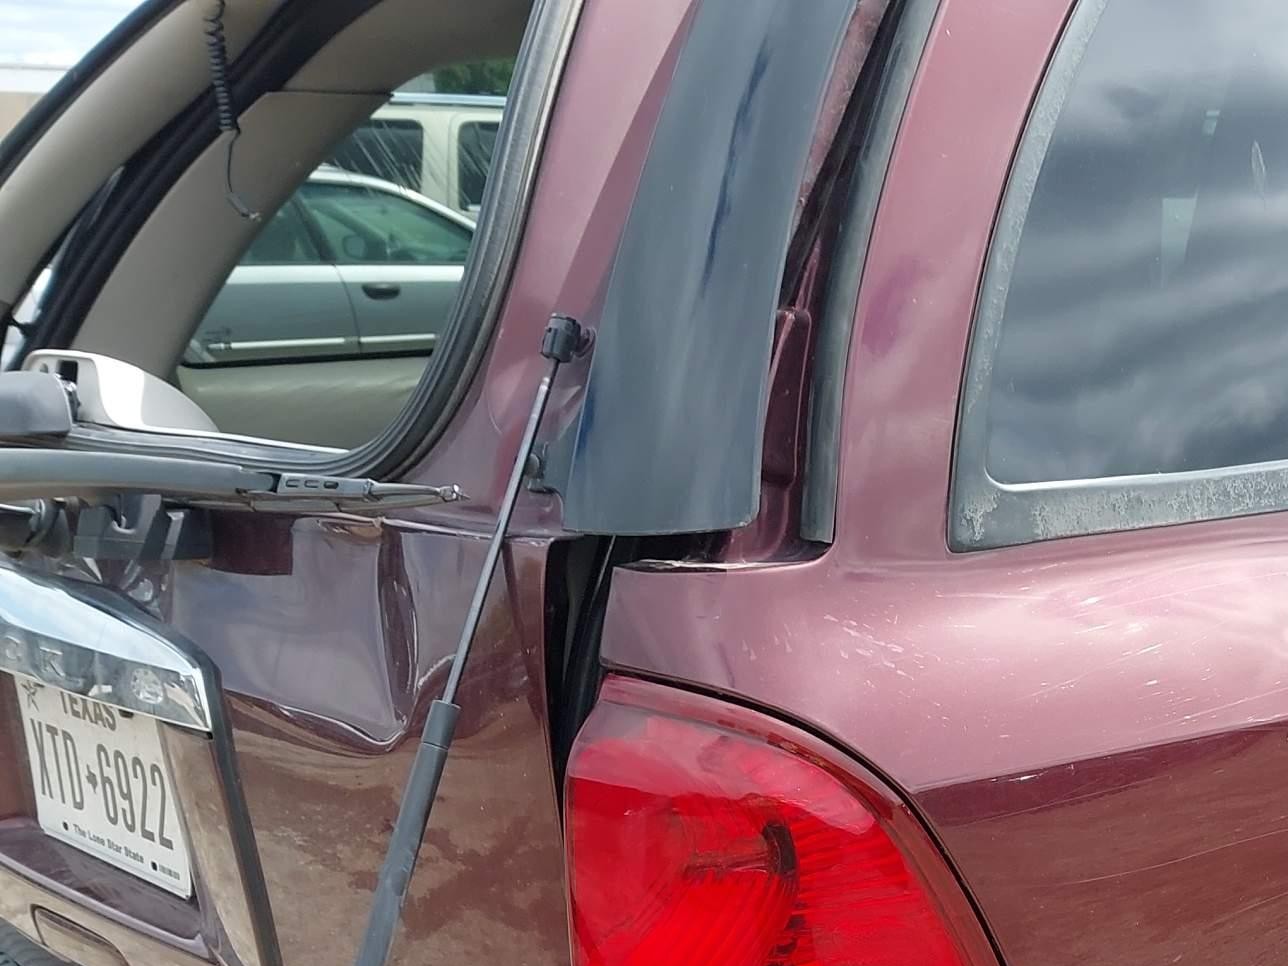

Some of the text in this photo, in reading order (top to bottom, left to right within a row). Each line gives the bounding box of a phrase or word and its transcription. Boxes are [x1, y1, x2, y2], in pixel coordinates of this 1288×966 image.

[60, 690, 117, 732] TEXAS
[73, 823, 145, 864] The Lone Star State
